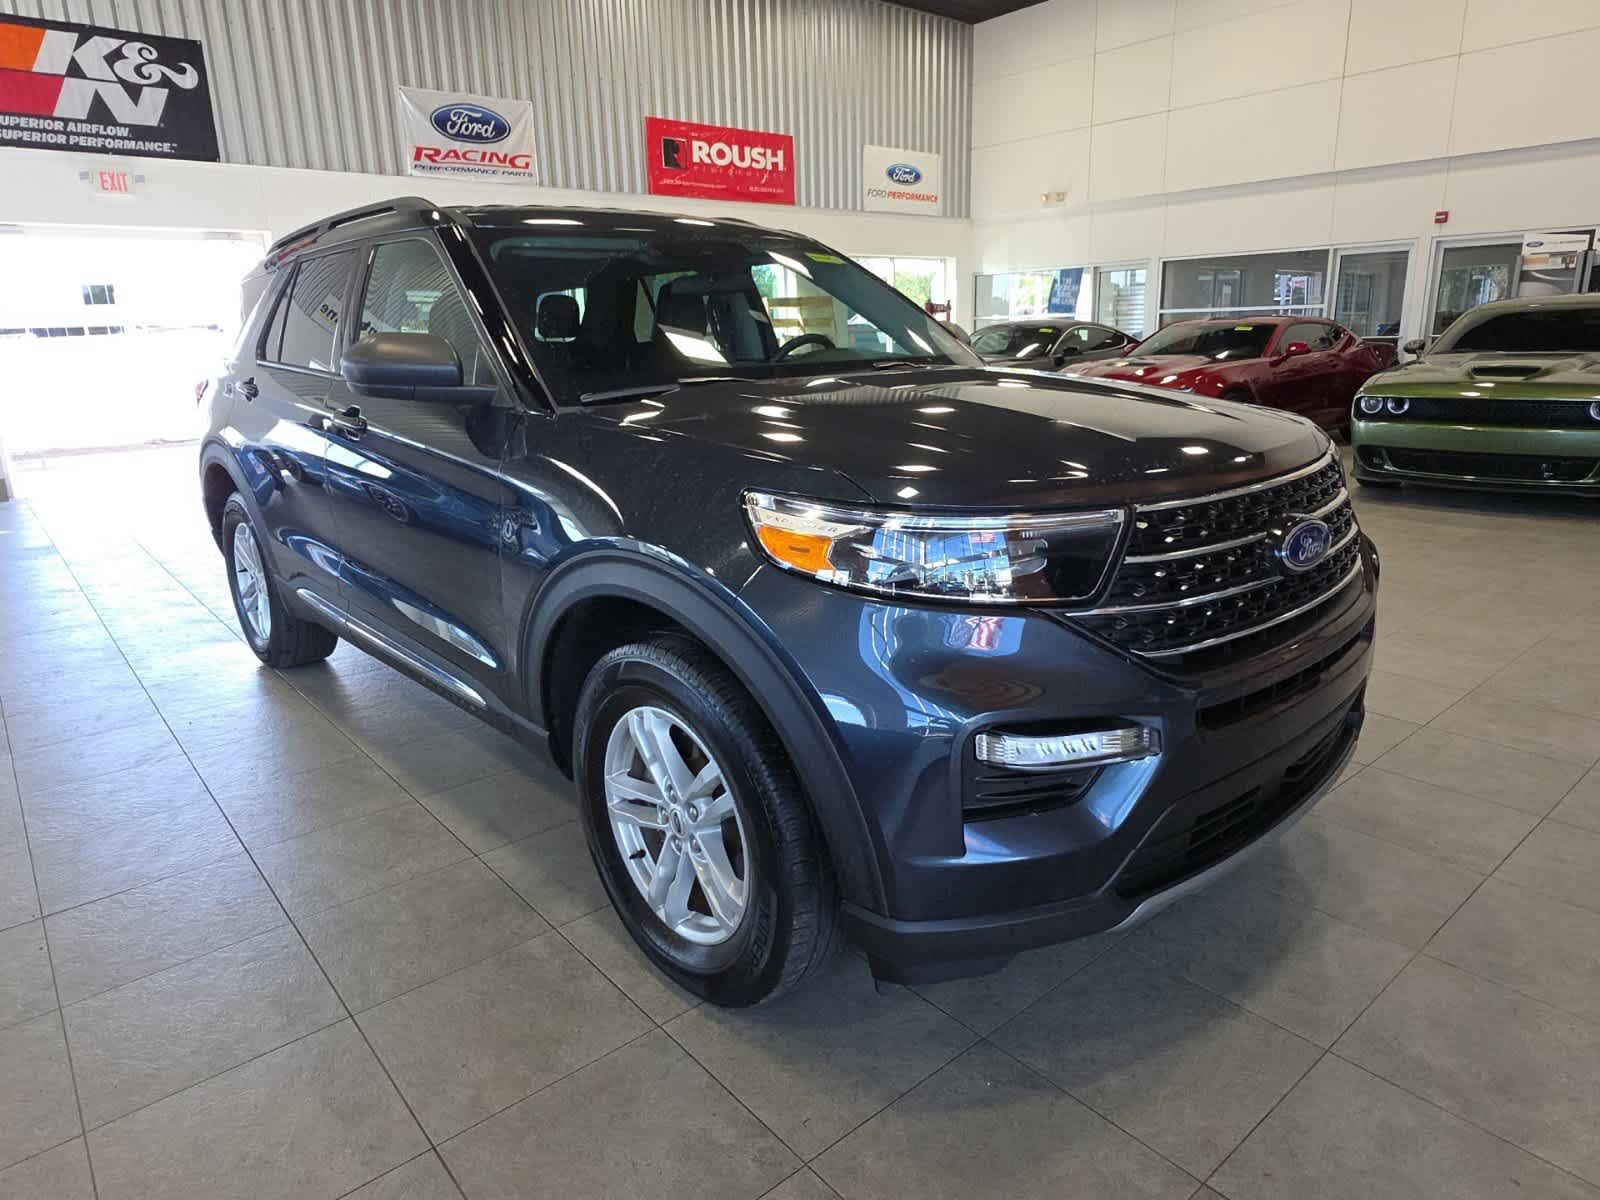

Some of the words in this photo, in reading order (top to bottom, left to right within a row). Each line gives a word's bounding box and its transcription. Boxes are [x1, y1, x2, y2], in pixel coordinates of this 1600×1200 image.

[0, 115, 64, 131] UPERIOR
[447, 108, 496, 138] Ford
[0, 129, 67, 144] UPERIOR
[413, 146, 532, 169] RACING
[691, 140, 784, 171] ROUSH
[414, 164, 498, 175] PERFORMANCE
[502, 169, 533, 177] PARTS
[892, 167, 916, 182] Ford
[98, 171, 128, 192] EXIT
[887, 190, 938, 203] PERFORMANCE
[1299, 532, 1325, 560] Ford
